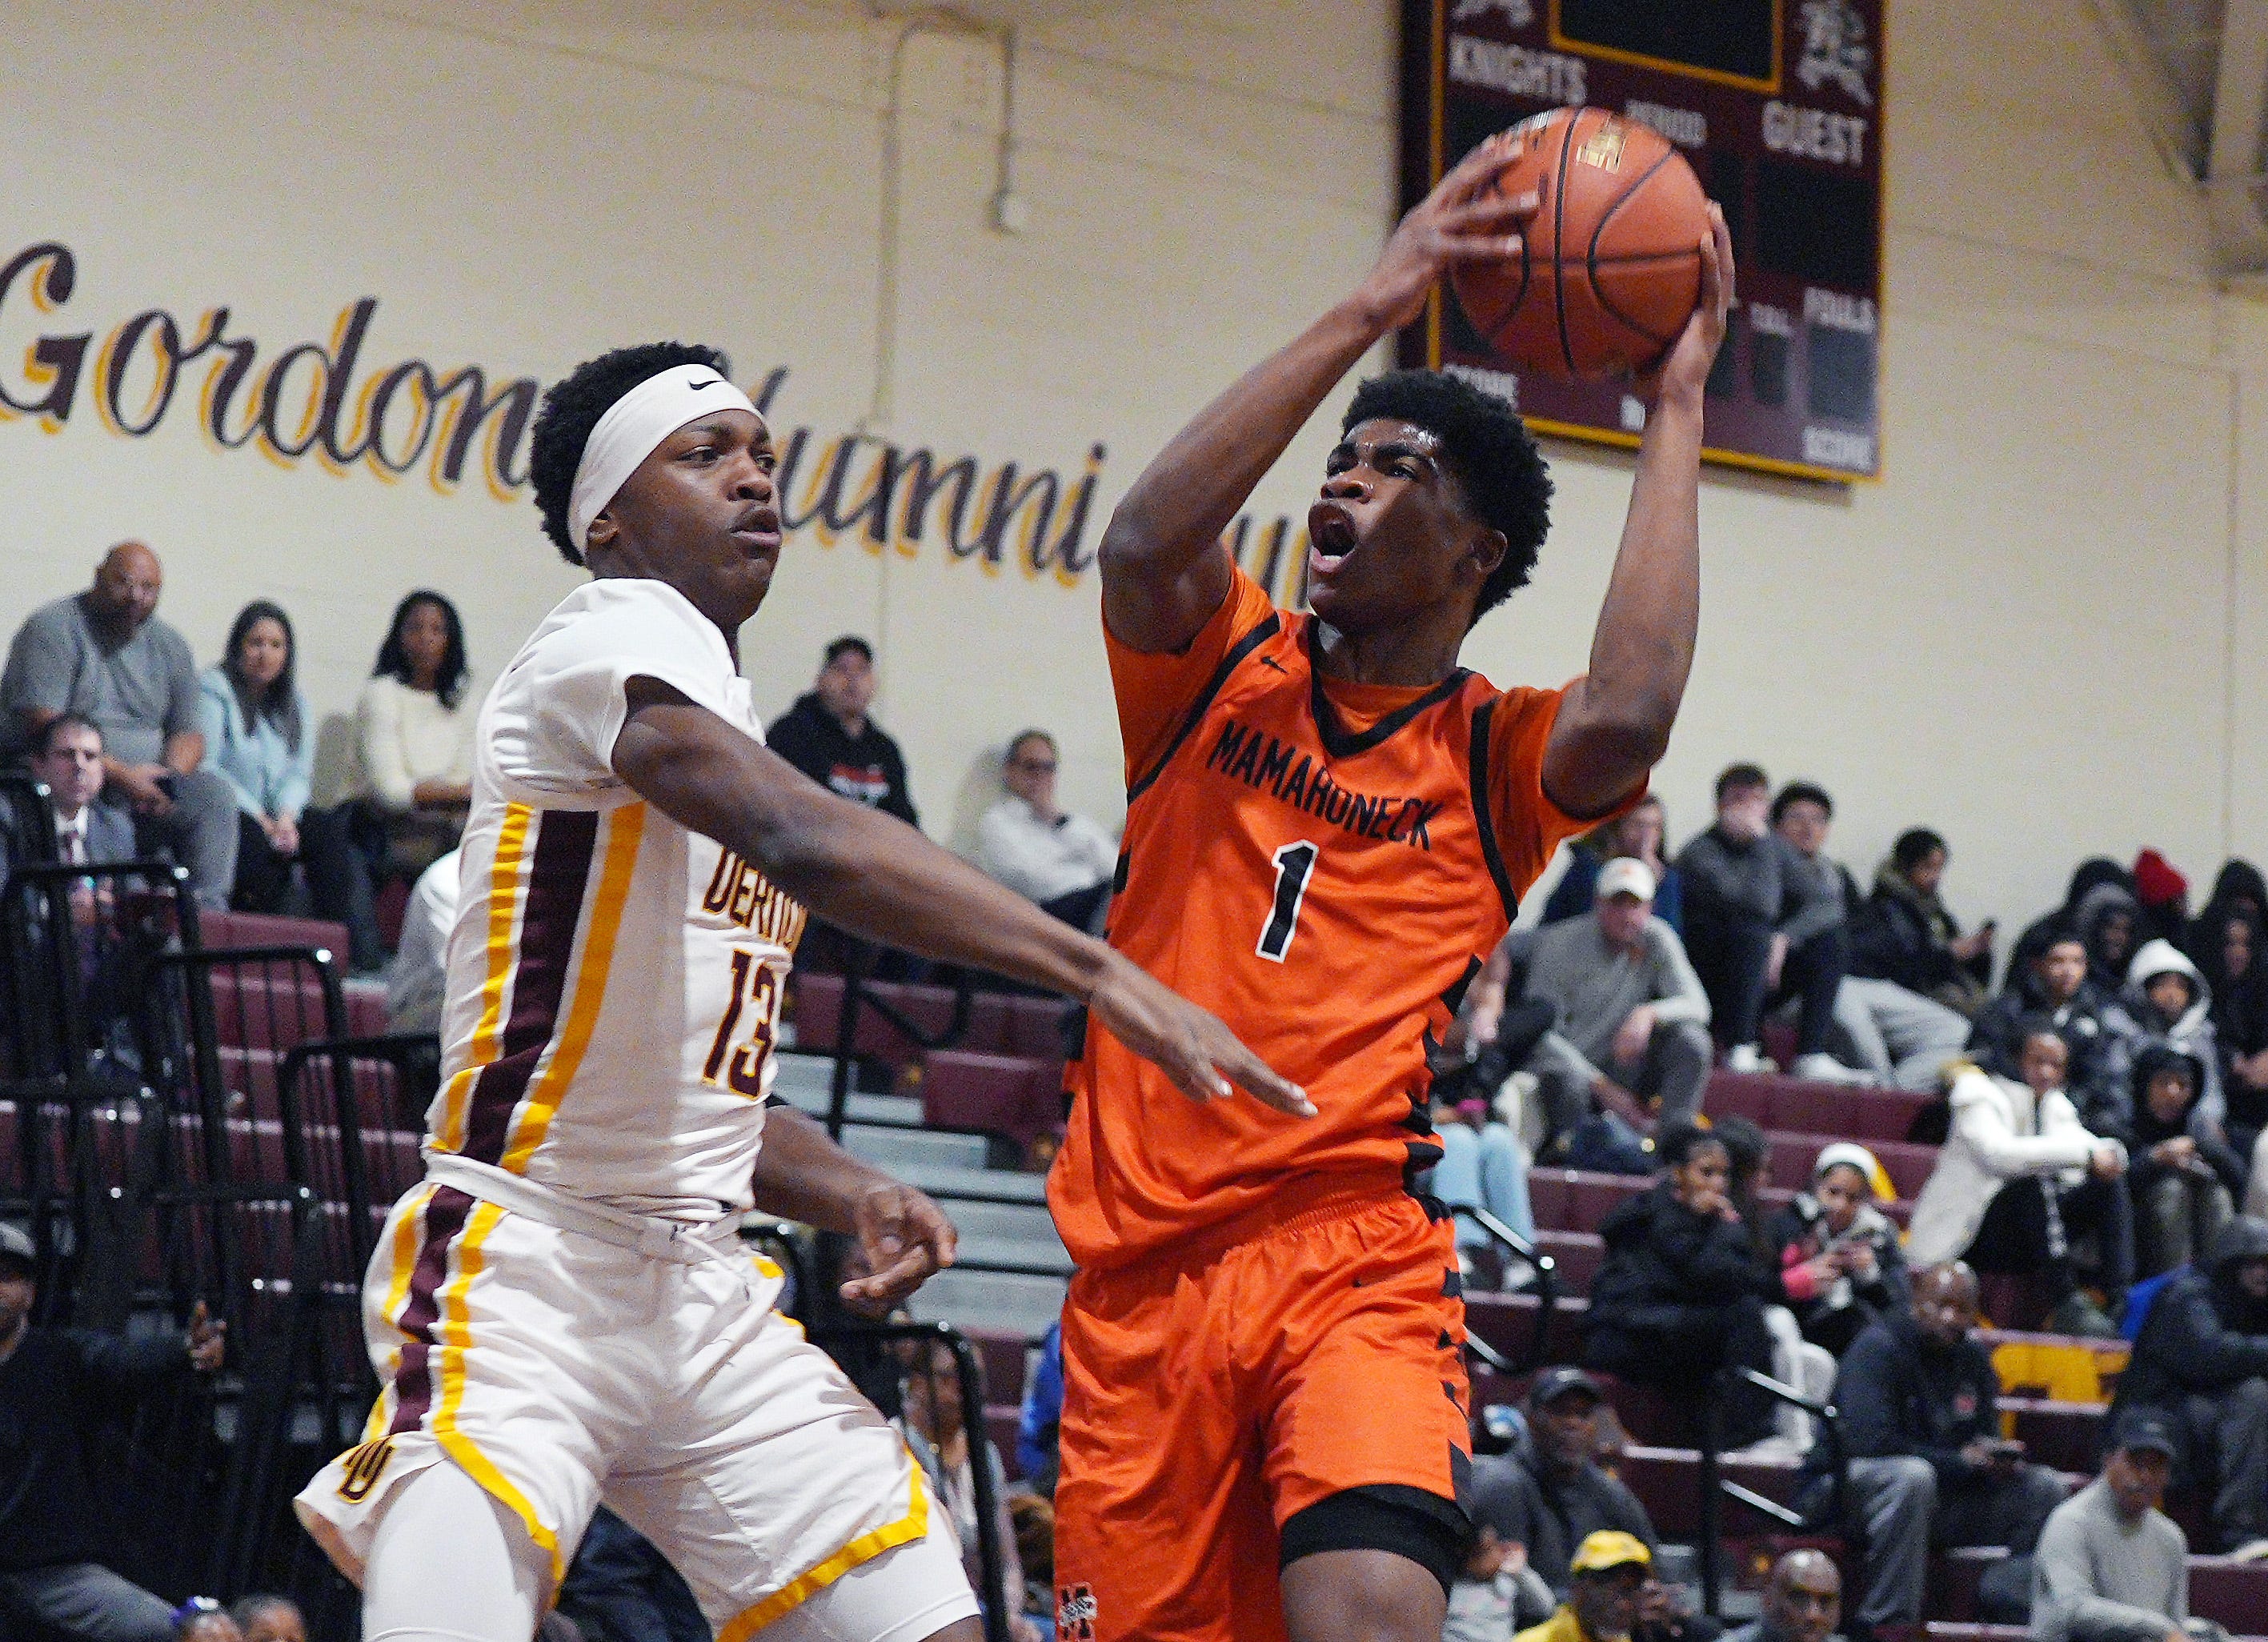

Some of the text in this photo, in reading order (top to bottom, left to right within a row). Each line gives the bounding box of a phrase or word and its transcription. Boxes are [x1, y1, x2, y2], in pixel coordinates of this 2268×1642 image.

[1761, 99, 1866, 165] GUEST
[0, 242, 538, 504] Gordon
[748, 364, 1096, 588] umni
[1256, 839, 1319, 963] 1
[699, 947, 776, 1099] 13
